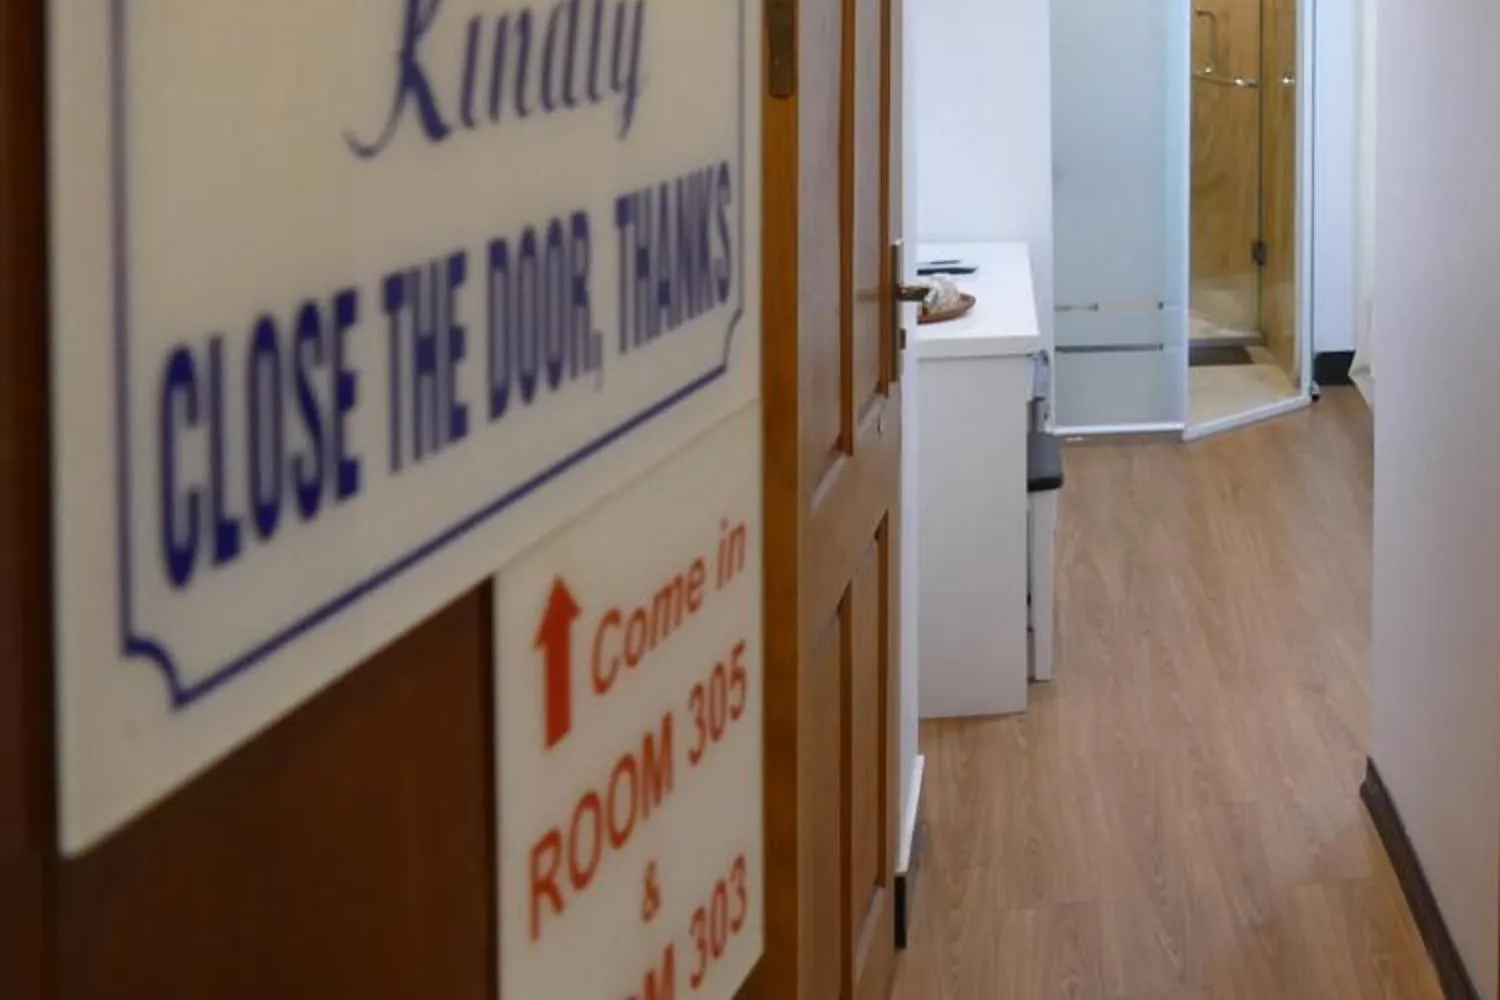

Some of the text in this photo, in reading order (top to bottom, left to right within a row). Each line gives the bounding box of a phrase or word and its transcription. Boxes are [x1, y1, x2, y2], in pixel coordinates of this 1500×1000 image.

[159, 286, 361, 590] CLOSE
[381, 250, 468, 475] THE
[615, 160, 732, 355] THANKS
[591, 518, 746, 696] Come in
[529, 710, 675, 943] ROOM
[688, 640, 747, 768] 305
[641, 860, 662, 924] &
[690, 855, 747, 990] 303
